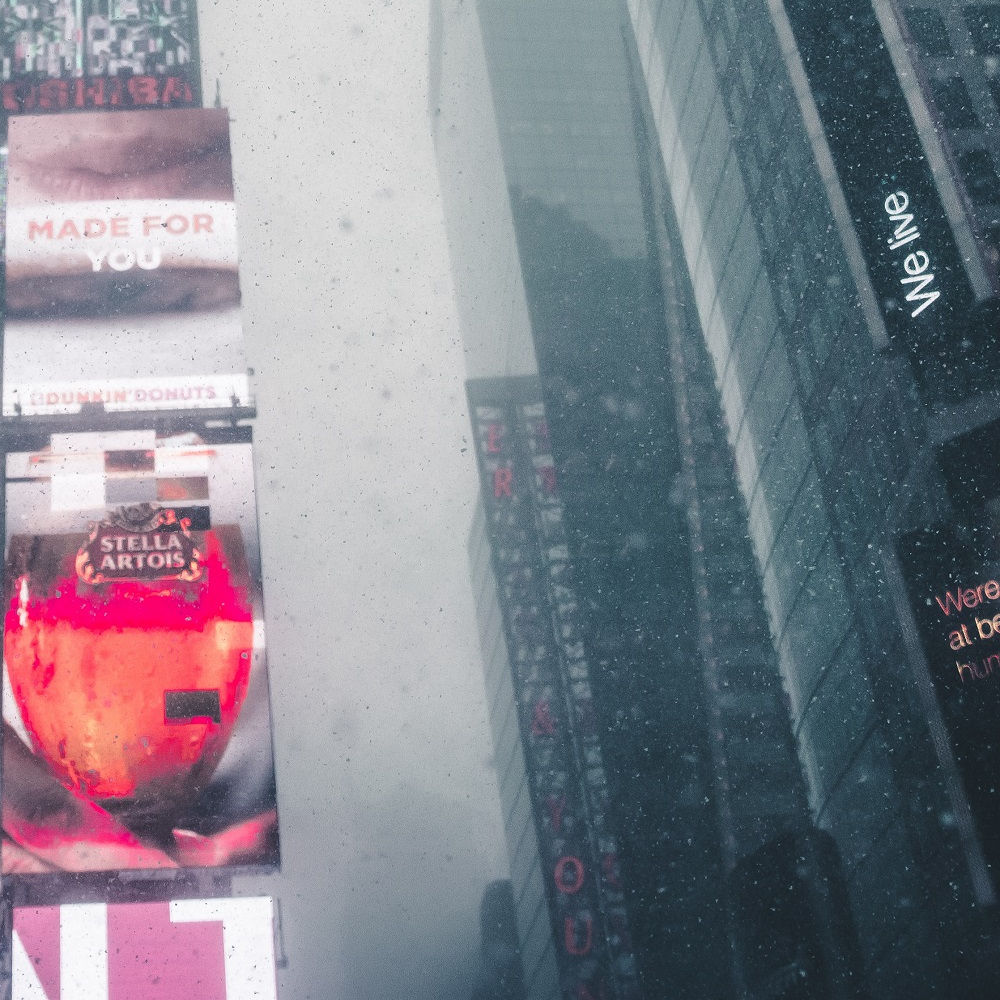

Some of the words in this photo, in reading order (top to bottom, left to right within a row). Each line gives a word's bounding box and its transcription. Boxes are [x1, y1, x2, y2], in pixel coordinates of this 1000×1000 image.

[27, 216, 131, 241] MADE
[141, 213, 215, 237] FOR
[884, 190, 920, 250] live
[87, 246, 163, 272] YOU
[900, 250, 941, 318] We
[134, 385, 217, 402] DONUTS
[101, 533, 184, 553] STELLA
[100, 550, 186, 571] ARTOIS
